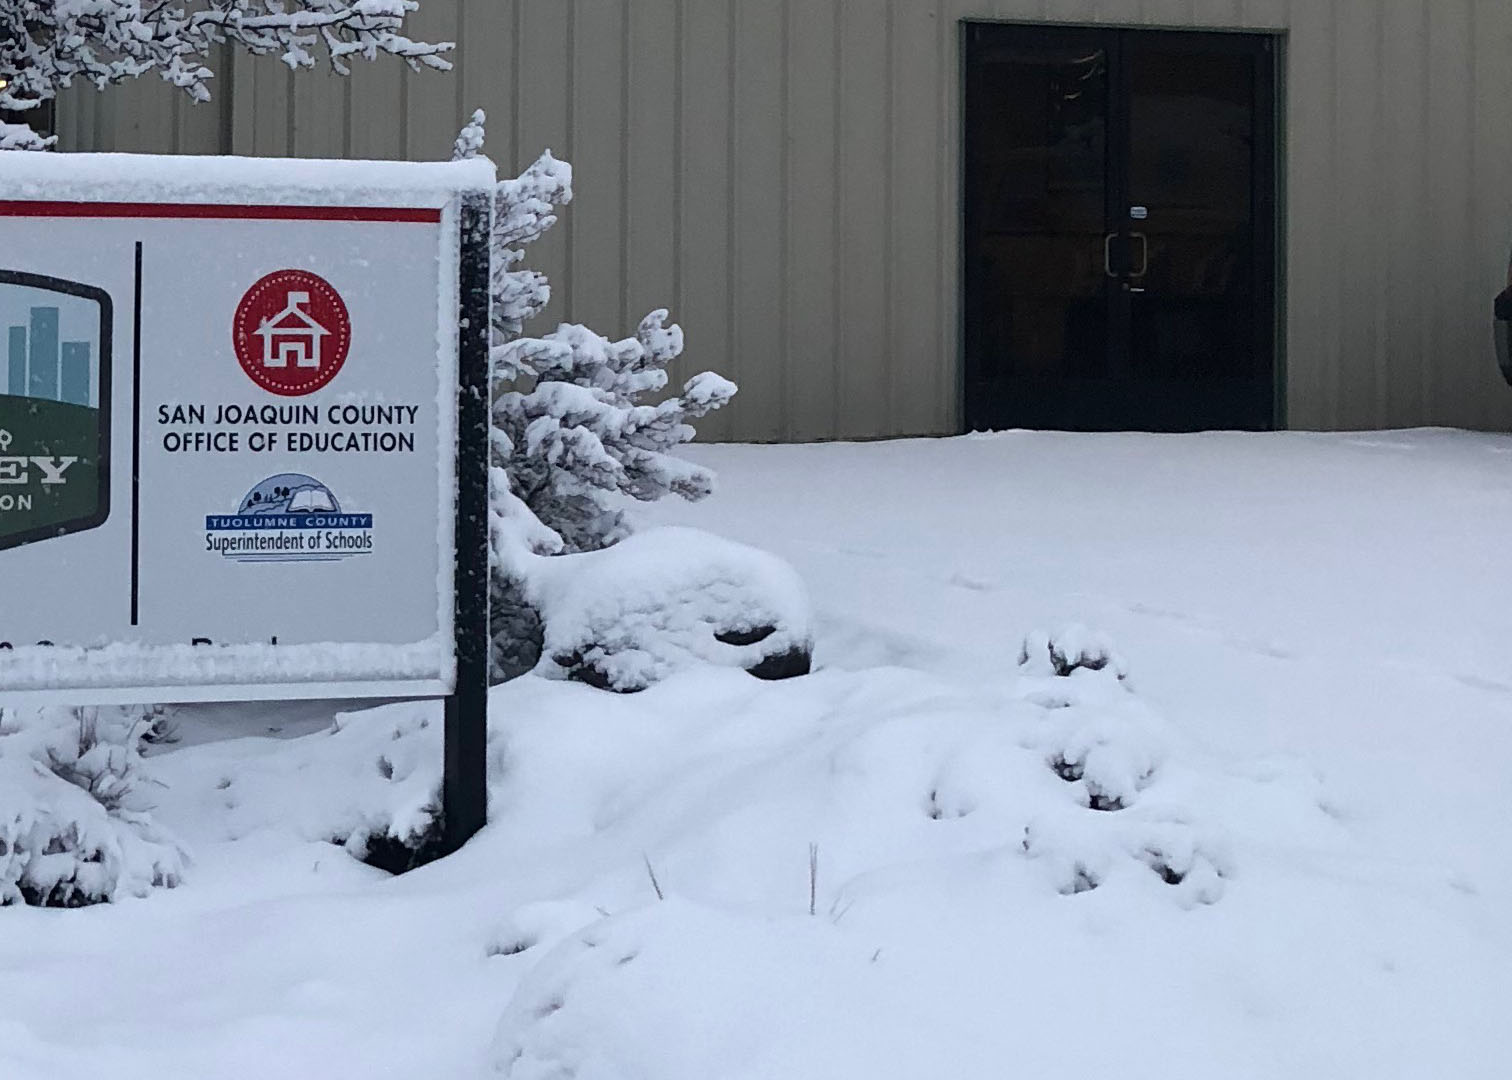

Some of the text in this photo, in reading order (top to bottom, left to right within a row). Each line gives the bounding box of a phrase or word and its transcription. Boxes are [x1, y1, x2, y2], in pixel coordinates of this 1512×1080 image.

[158, 404, 419, 425] SAN JOAQUIN COUNTY
[163, 432, 415, 452] OFFICE OF EDUCATION
[211, 516, 368, 528] TUOLUMNE COUNTY
[206, 529, 372, 555] Superintendent of Schools
